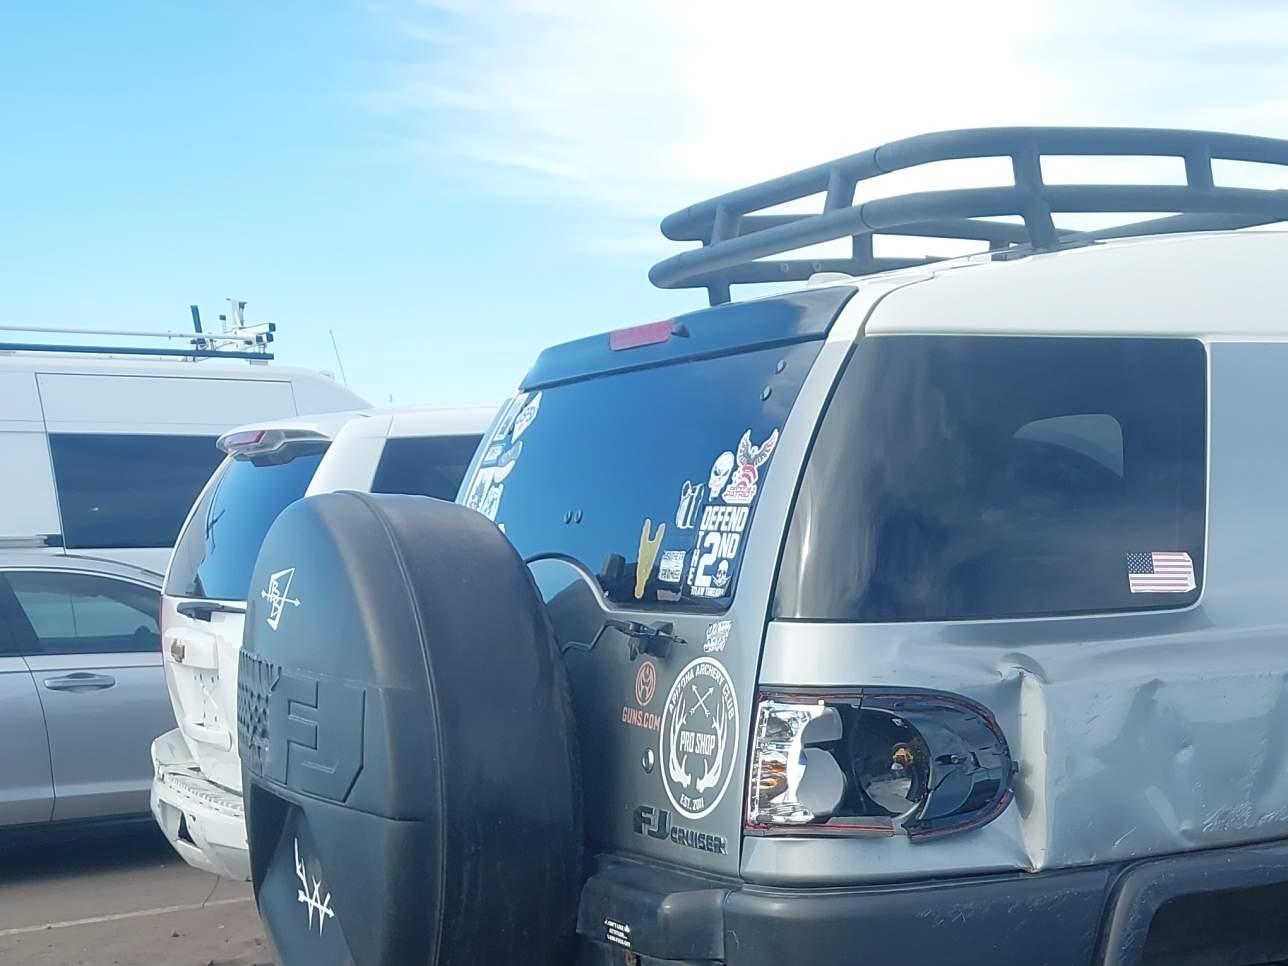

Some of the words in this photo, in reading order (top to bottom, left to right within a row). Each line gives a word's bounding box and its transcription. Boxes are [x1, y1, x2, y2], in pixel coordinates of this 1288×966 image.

[700, 506, 750, 531] DEFEND
[687, 531, 705, 586] THE
[694, 531, 740, 587] 2ND
[695, 663, 726, 687] ARCHERY
[722, 683, 735, 721] CLUB
[621, 706, 661, 732] GUNS.COM
[679, 731, 695, 753] PRO
[694, 732, 716, 757] SHOP
[633, 805, 671, 841] FJ
[670, 825, 729, 857] CRUISER
